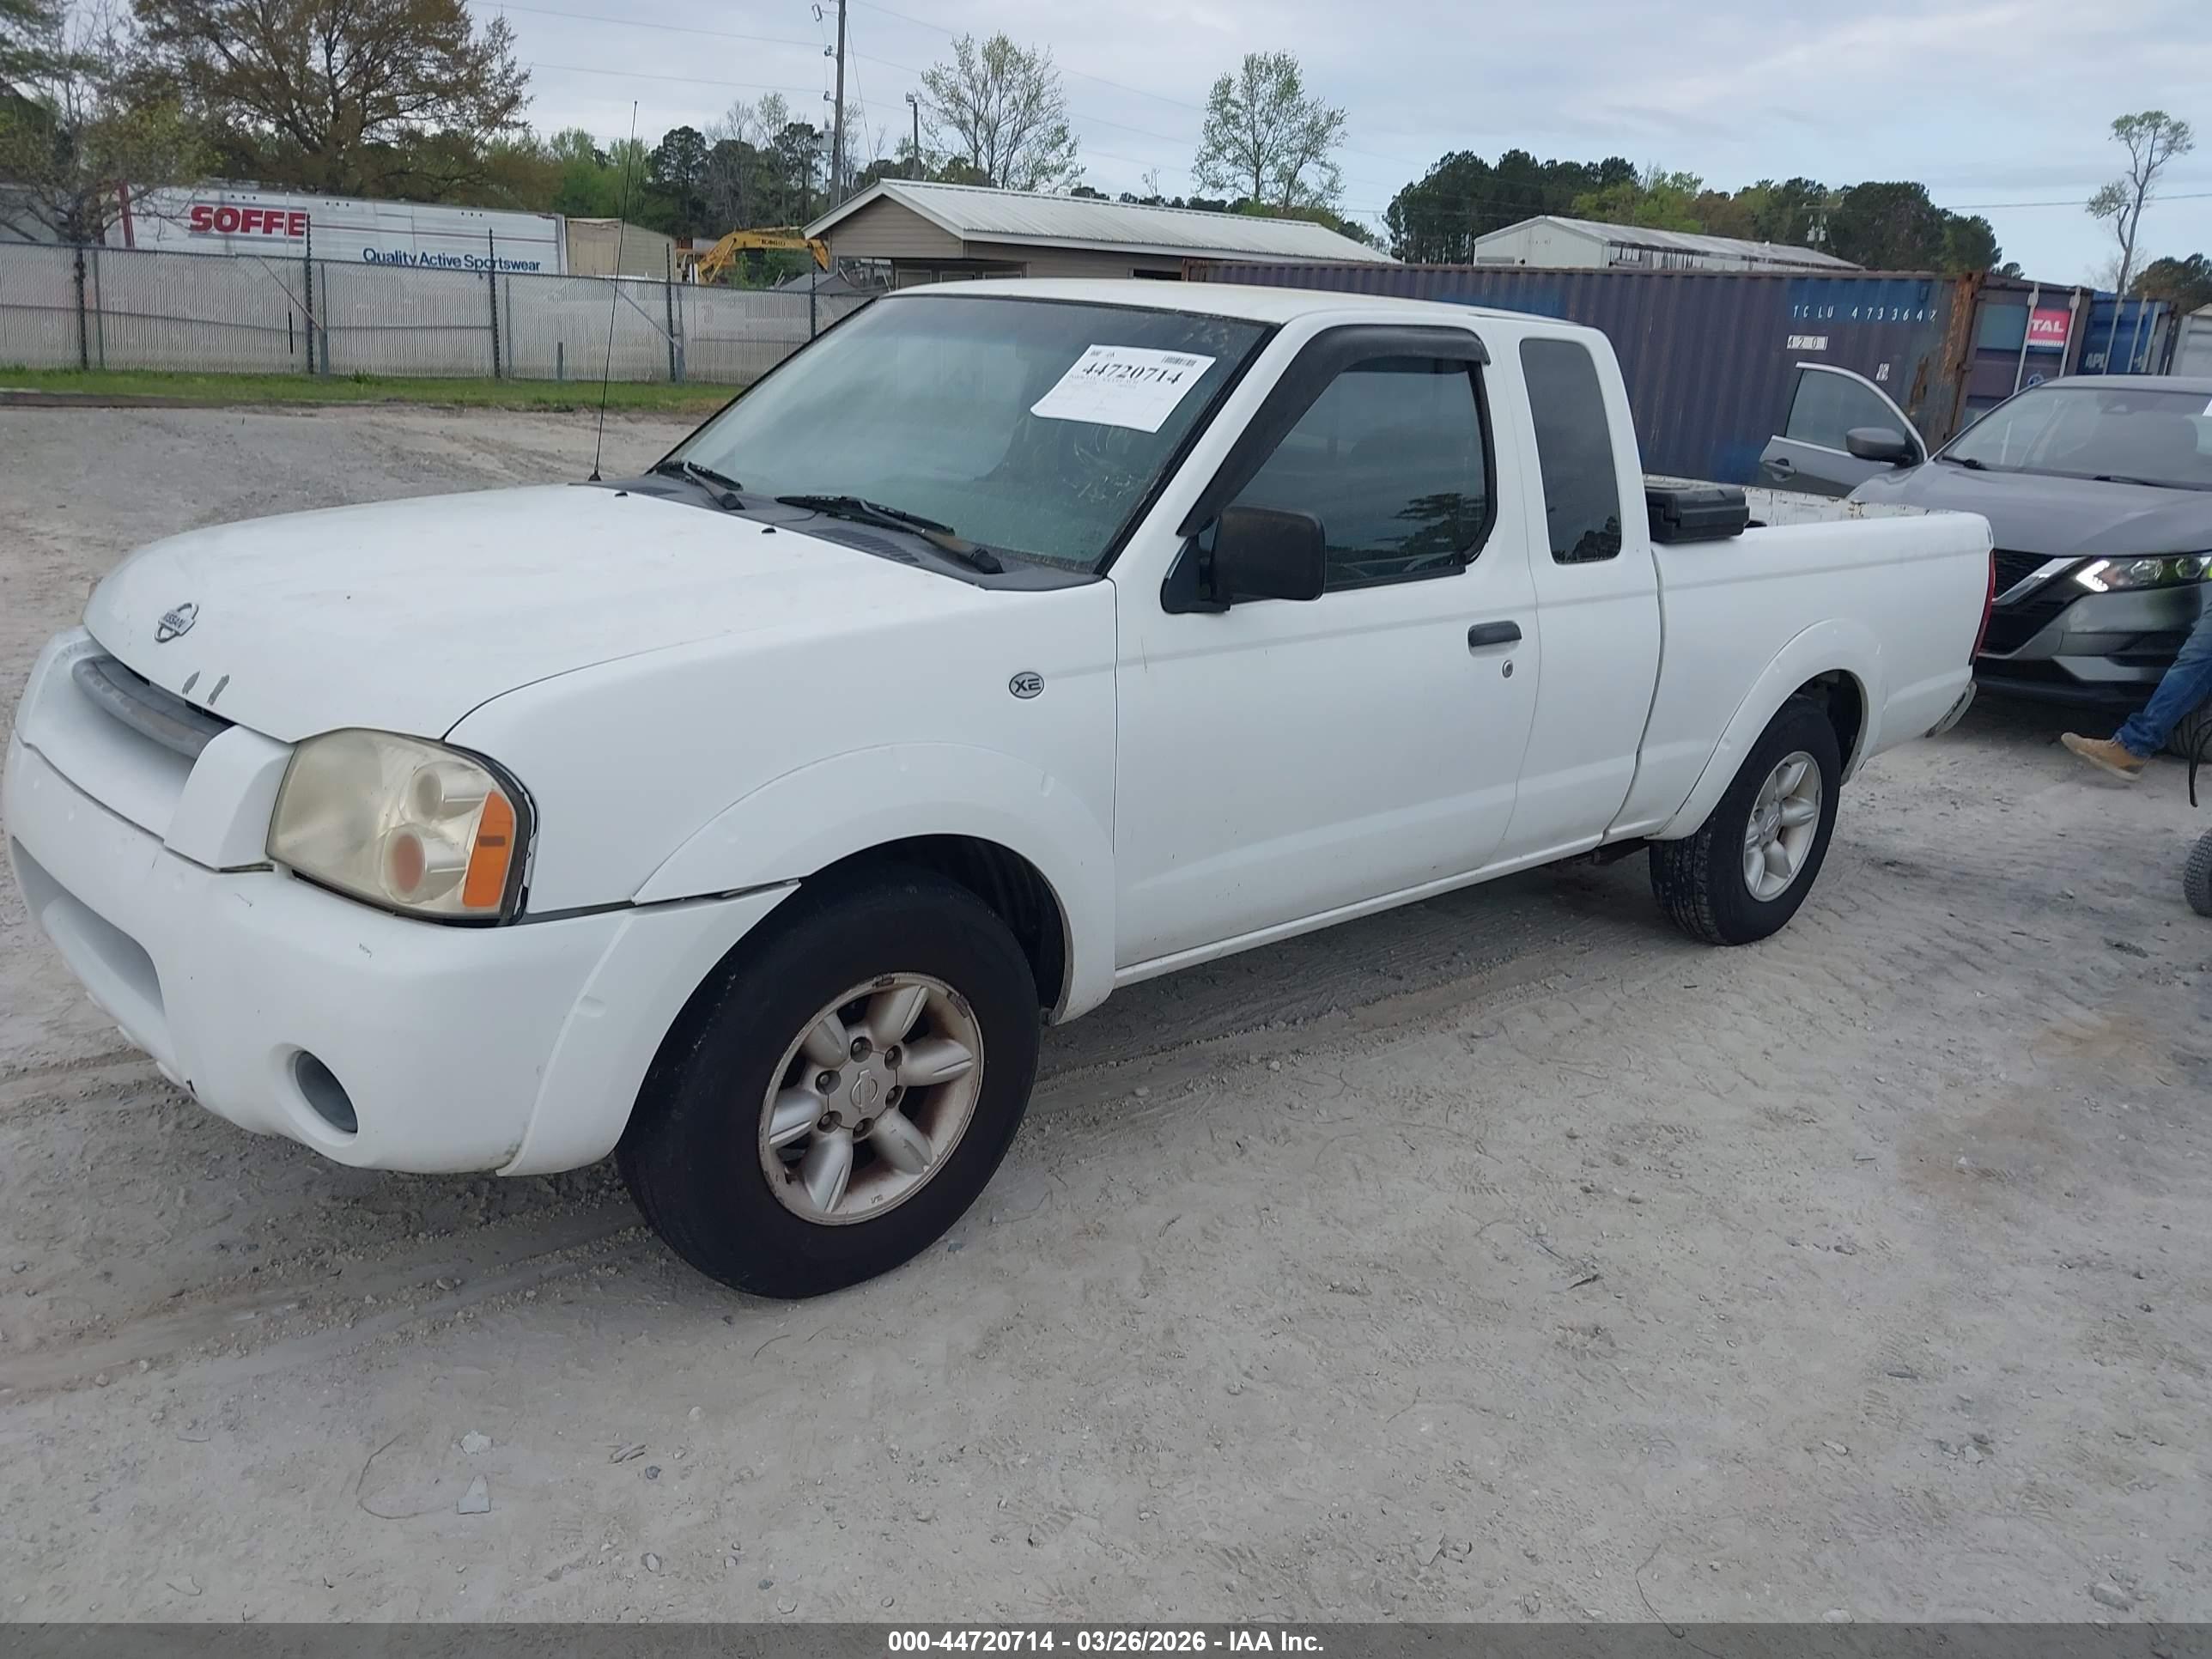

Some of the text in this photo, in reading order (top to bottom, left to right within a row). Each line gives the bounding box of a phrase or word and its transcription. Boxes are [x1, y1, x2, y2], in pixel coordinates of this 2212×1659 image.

[190, 205, 307, 237] SOFFE
[362, 247, 541, 272] Quality Active Sportswear
[2032, 319, 2064, 333] TAL
[1082, 362, 1184, 385] 44720714
[1014, 678, 1042, 693] XE
